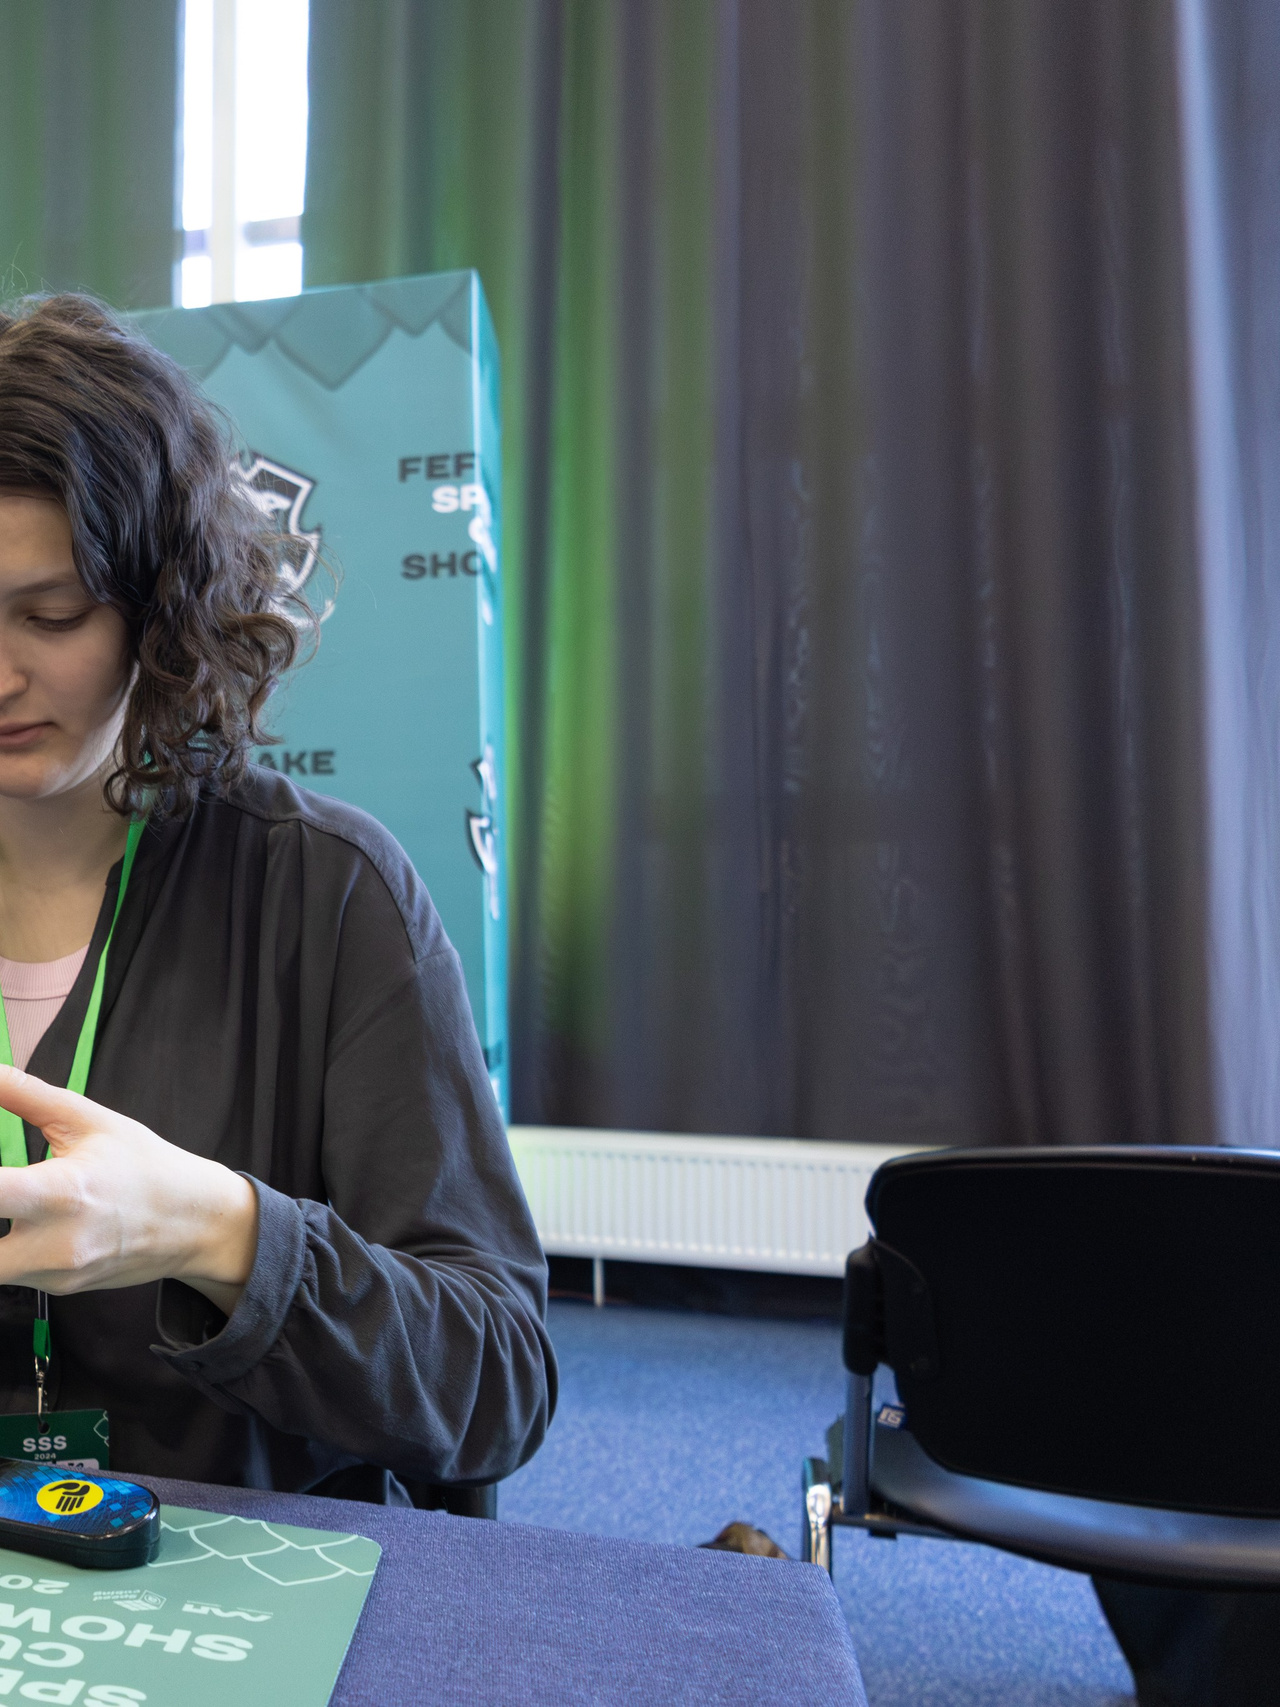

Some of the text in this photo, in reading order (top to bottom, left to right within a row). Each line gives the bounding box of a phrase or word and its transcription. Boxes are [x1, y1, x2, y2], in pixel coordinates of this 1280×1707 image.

[399, 453, 477, 483] FEF
[22, 1435, 67, 1453] SSS
[34, 1452, 57, 1460] 2024
